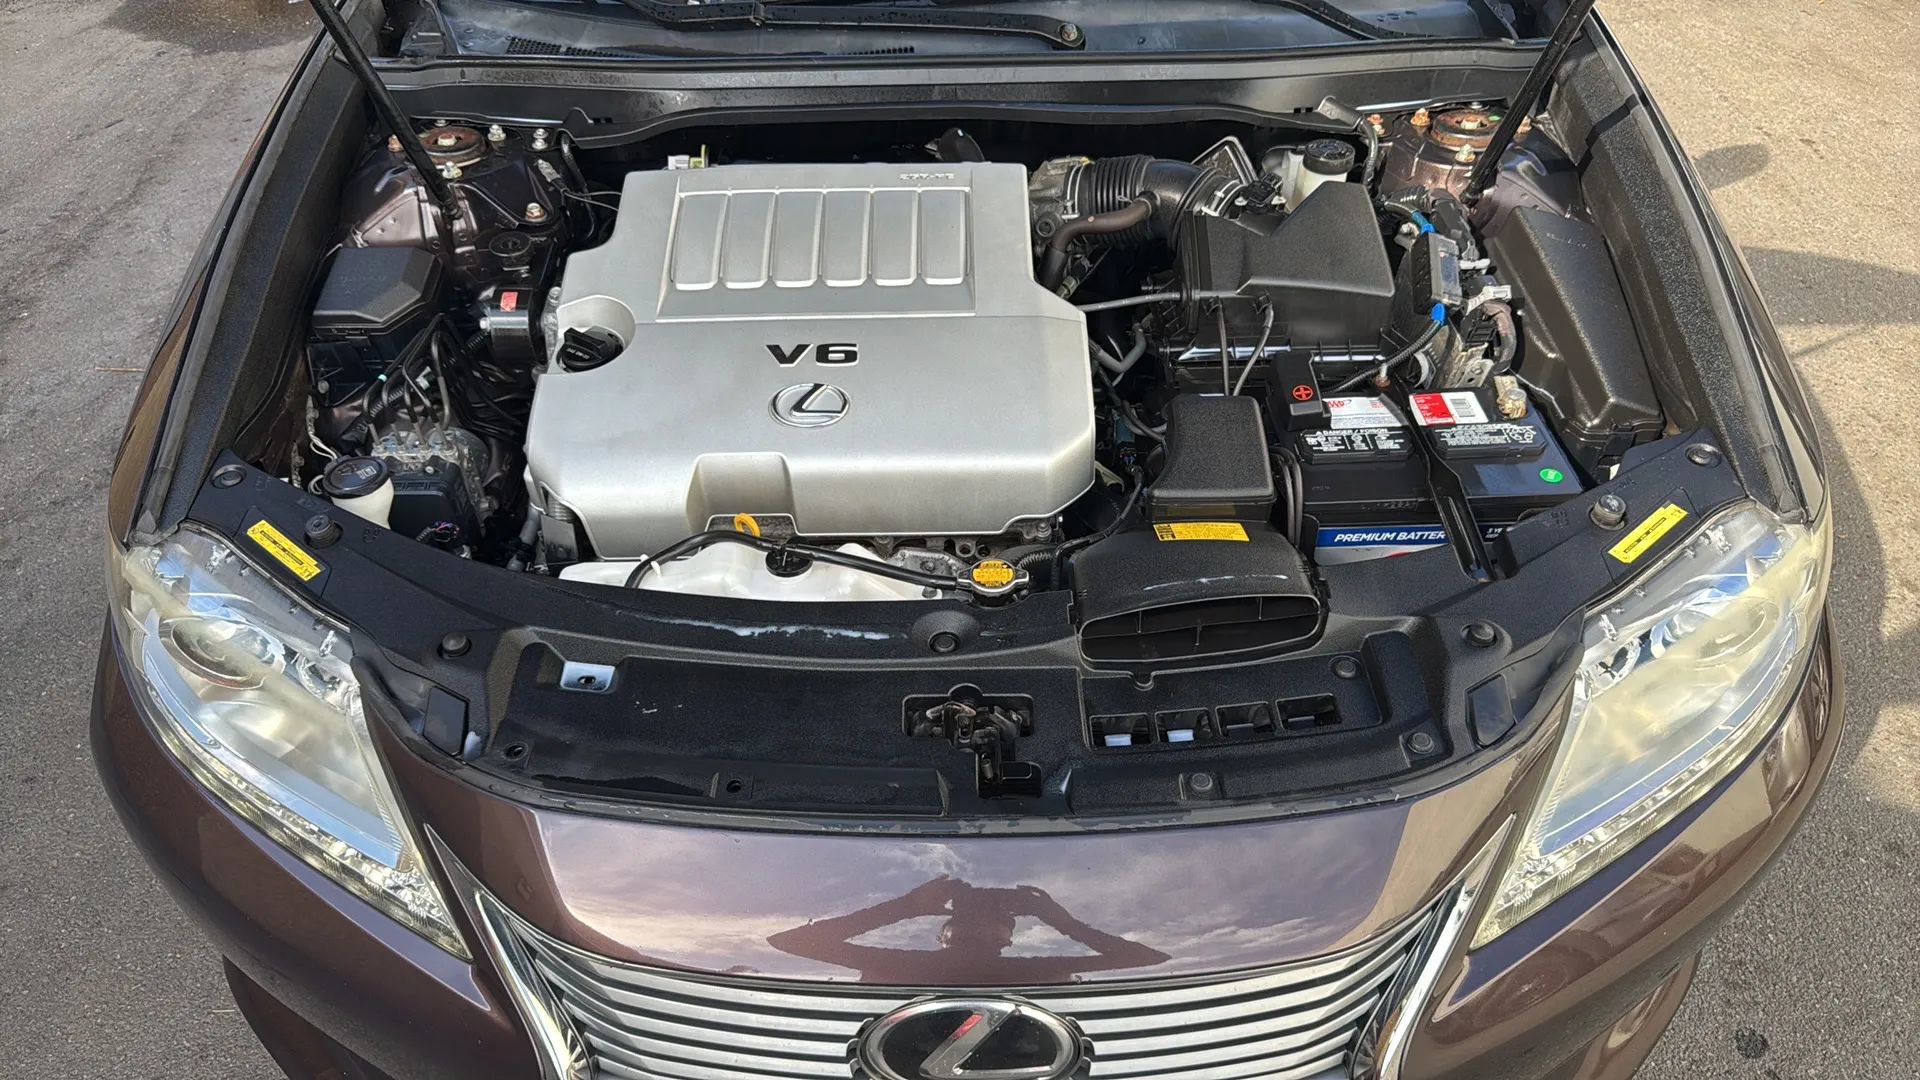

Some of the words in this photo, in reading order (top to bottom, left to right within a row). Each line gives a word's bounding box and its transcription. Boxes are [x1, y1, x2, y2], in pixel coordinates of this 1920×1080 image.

[764, 343, 859, 367] V6
[1334, 532, 1397, 543] PREMIUM
[1396, 530, 1447, 541] BATTER
